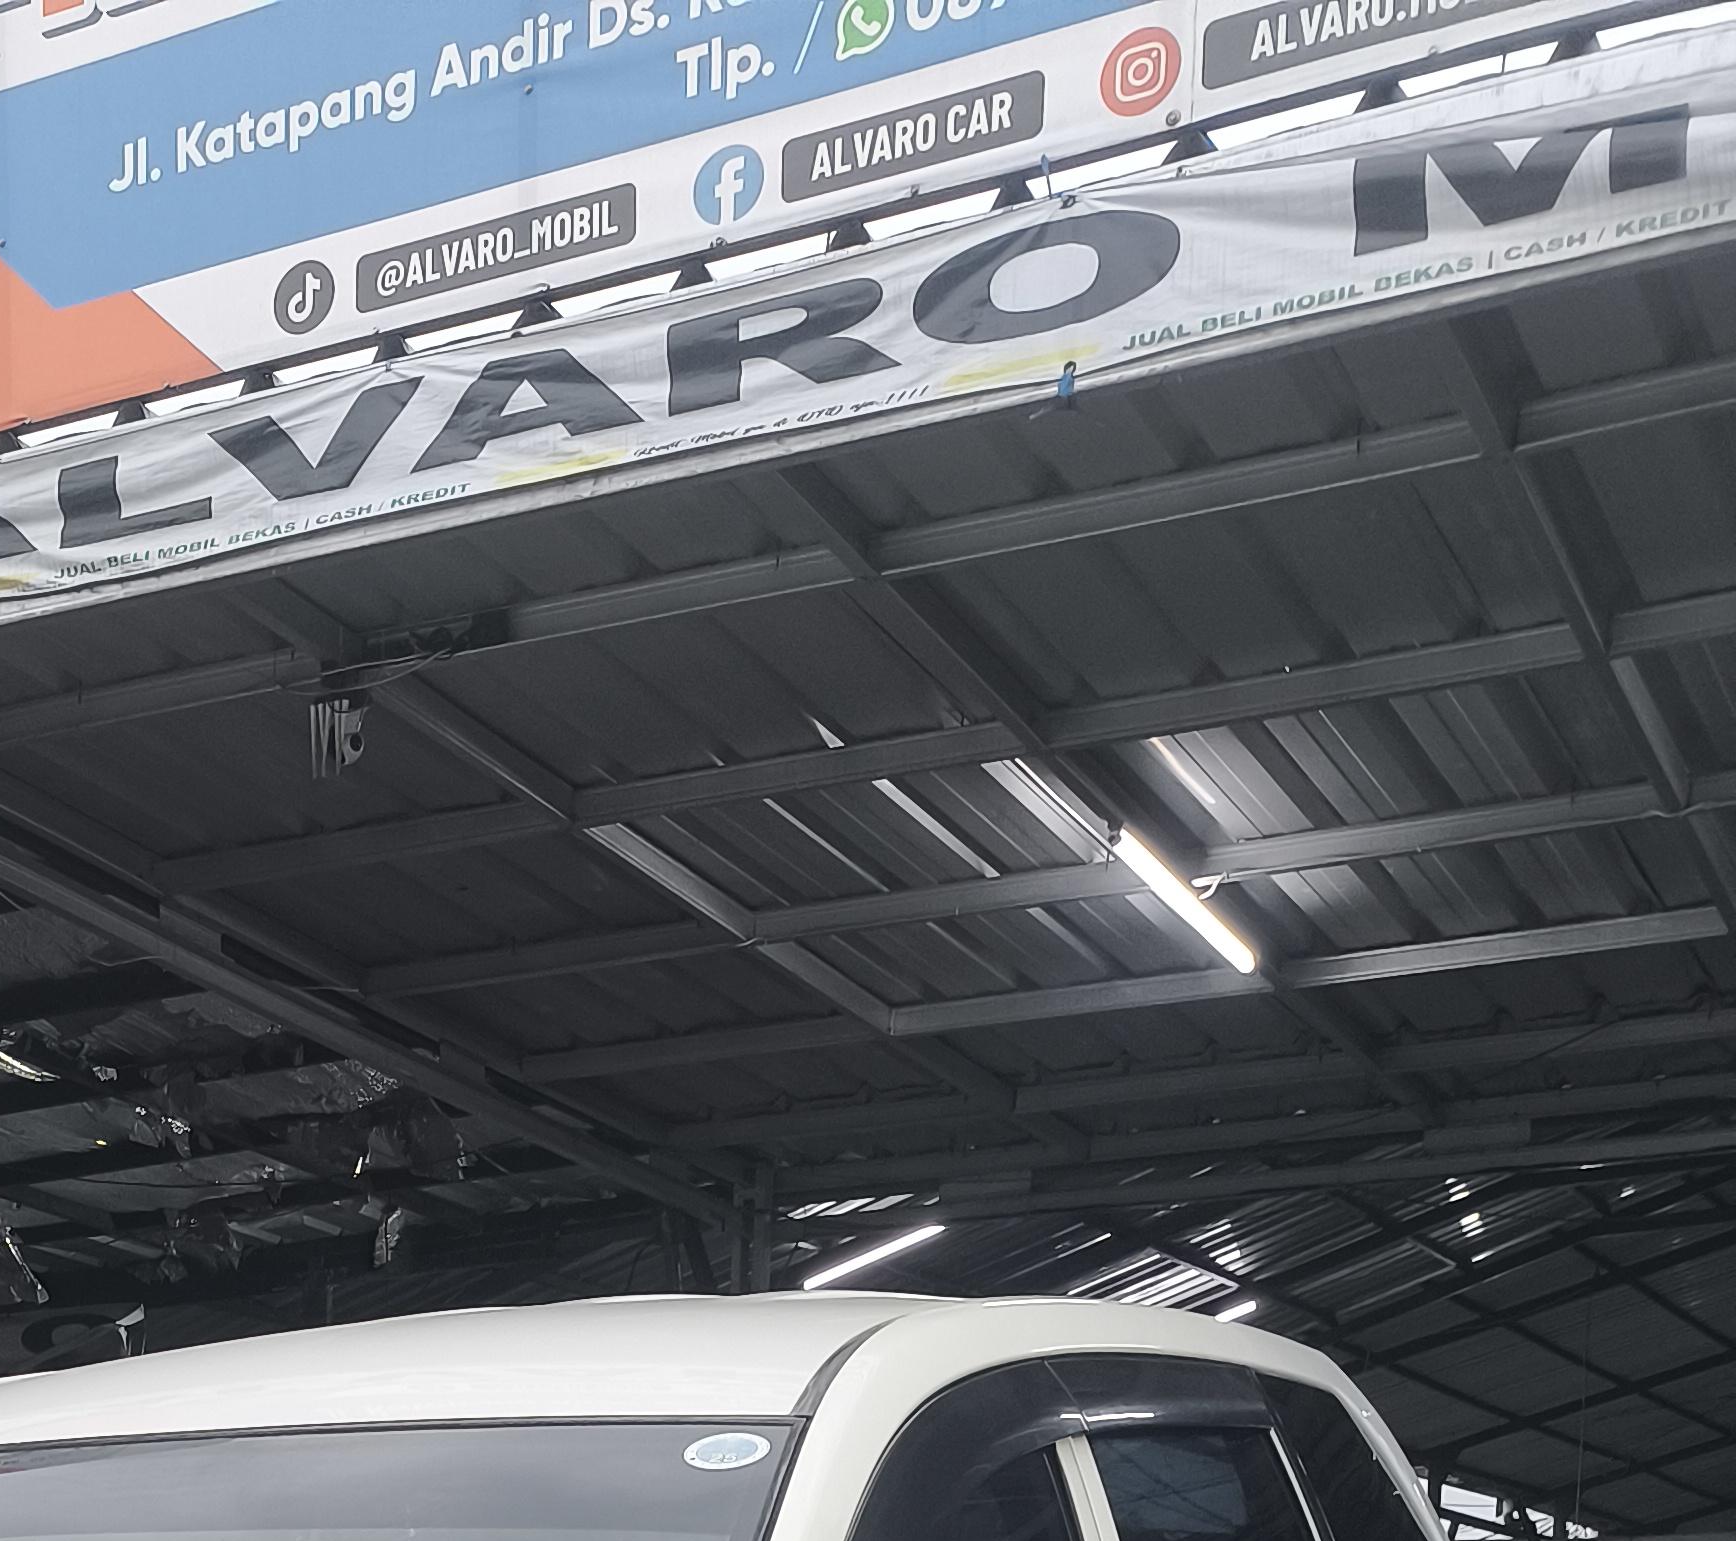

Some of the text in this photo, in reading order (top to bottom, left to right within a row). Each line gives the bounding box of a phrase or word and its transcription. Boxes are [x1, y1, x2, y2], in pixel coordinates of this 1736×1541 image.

[676, 36, 776, 100] Tlp.
[1250, 0, 1460, 61] ALVARO.
[107, 0, 671, 193] Jl. Katapang Andir Ds.
[809, 90, 1014, 182] ALVARO CAR
[374, 199, 621, 298] @ALVARO_MOBIL
[1121, 322, 1192, 352] JUAL
[1201, 306, 1263, 333] BELI
[1272, 282, 1364, 317] MOBIL
[1373, 254, 1474, 293] BEKAS
[1503, 229, 1588, 262] CASH
[1615, 199, 1733, 240] KREDIT
[54, 559, 102, 580] JUAL
[106, 550, 150, 569] BELI
[157, 536, 220, 560] MOBIL
[227, 520, 296, 546] BEKAS
[315, 502, 373, 526] CASH
[390, 481, 472, 509] KREDIT
